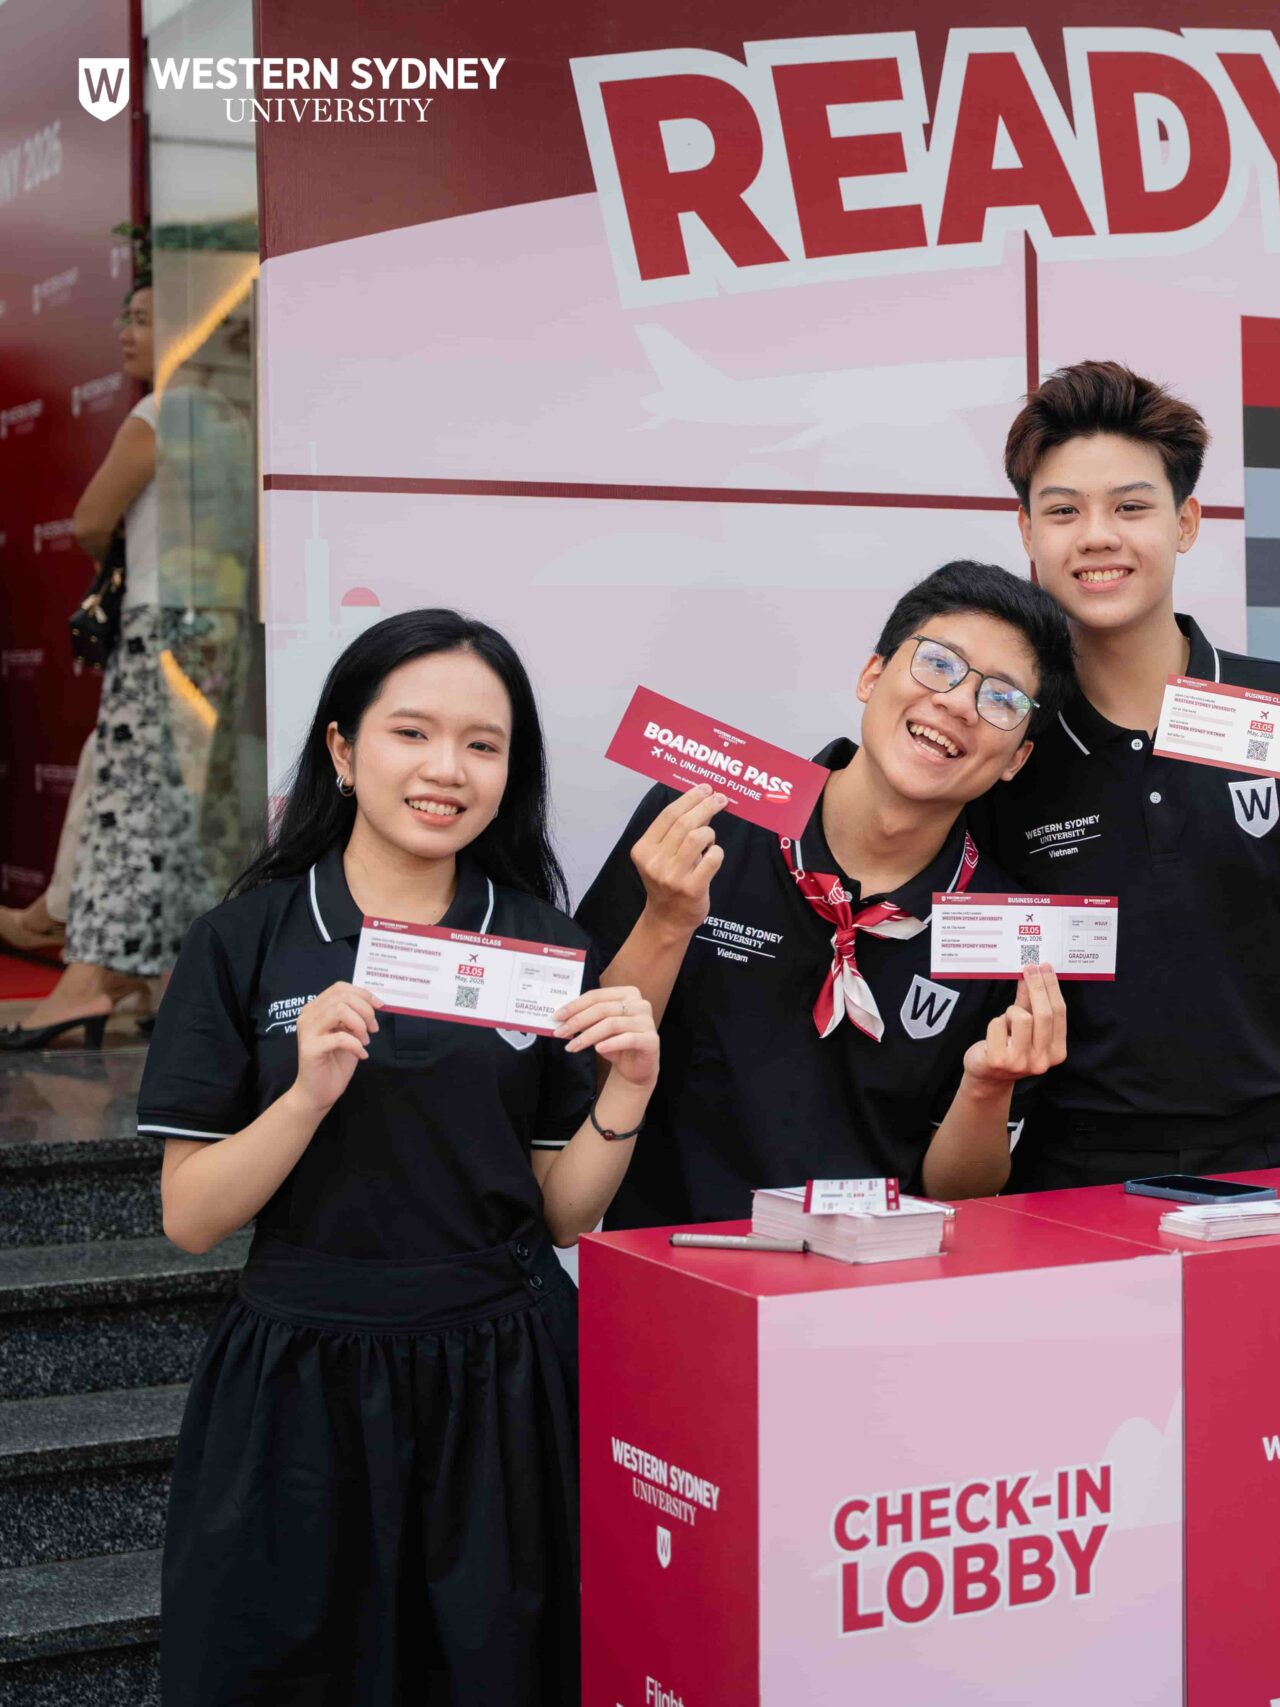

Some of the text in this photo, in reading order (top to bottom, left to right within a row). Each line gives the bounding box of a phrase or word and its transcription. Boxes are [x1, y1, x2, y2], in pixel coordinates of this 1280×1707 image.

[1244, 691, 1272, 702] BUSINESS
[643, 721, 793, 796] BOARDING PASS
[663, 752, 678, 765] No.
[679, 759, 727, 785] UNLIMITED
[726, 780, 762, 801] FUTURE
[1235, 786, 1272, 822] W
[1025, 814, 1100, 841] WESTERN SYDNEY
[1039, 827, 1086, 845] UNIVERSITY
[1048, 846, 1079, 859] Vietnam
[450, 932, 503, 947] BUSINESS CLASS
[712, 928, 765, 949] UNIVERSITY
[744, 926, 784, 944] SYDNEY
[1020, 926, 1040, 934] 23.05
[716, 946, 749, 963] Vietnam
[459, 965, 483, 977] 23.05
[515, 1002, 556, 1014] GRADUATED
[910, 984, 952, 1029] W
[611, 1435, 720, 1512] WESTERN SYDNEY
[632, 1475, 697, 1526] UNIVERSITY
[833, 1464, 1112, 1552] CHECK-IN
[841, 1523, 1110, 1634] LOBBY
